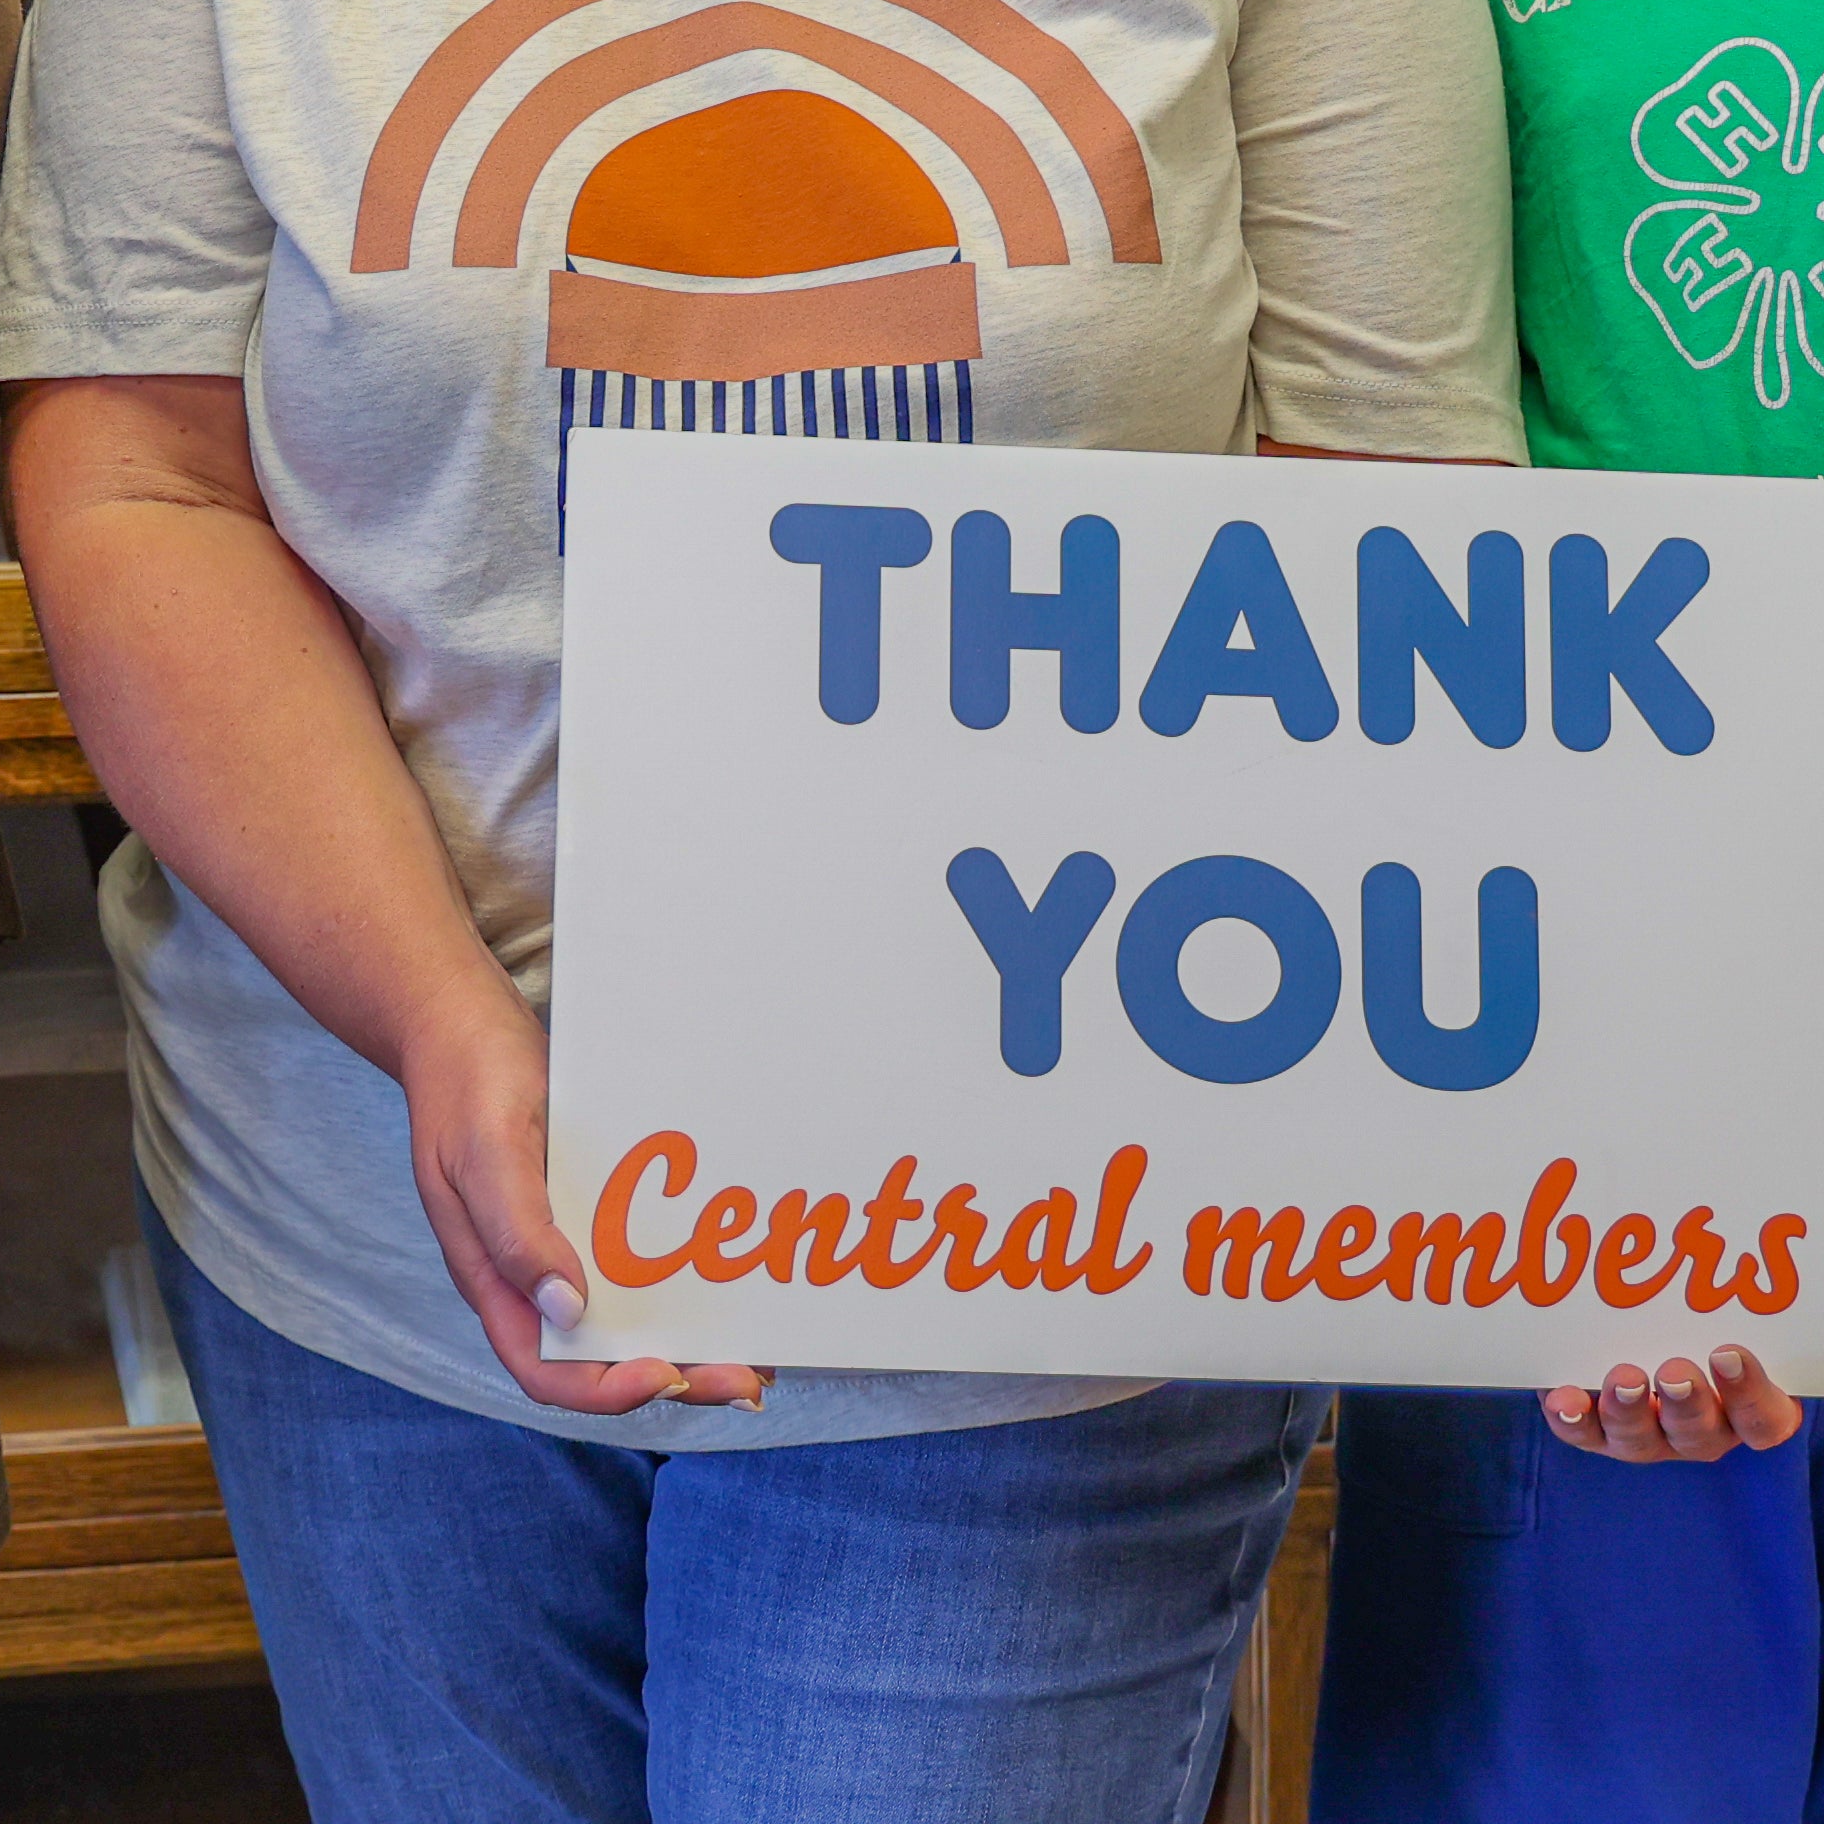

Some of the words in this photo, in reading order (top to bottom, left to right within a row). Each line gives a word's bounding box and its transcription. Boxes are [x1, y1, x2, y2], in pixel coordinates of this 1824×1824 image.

[768, 501, 1717, 757] THANK
[945, 845, 1541, 1092] YOU
[591, 1129, 1155, 1295] Central
